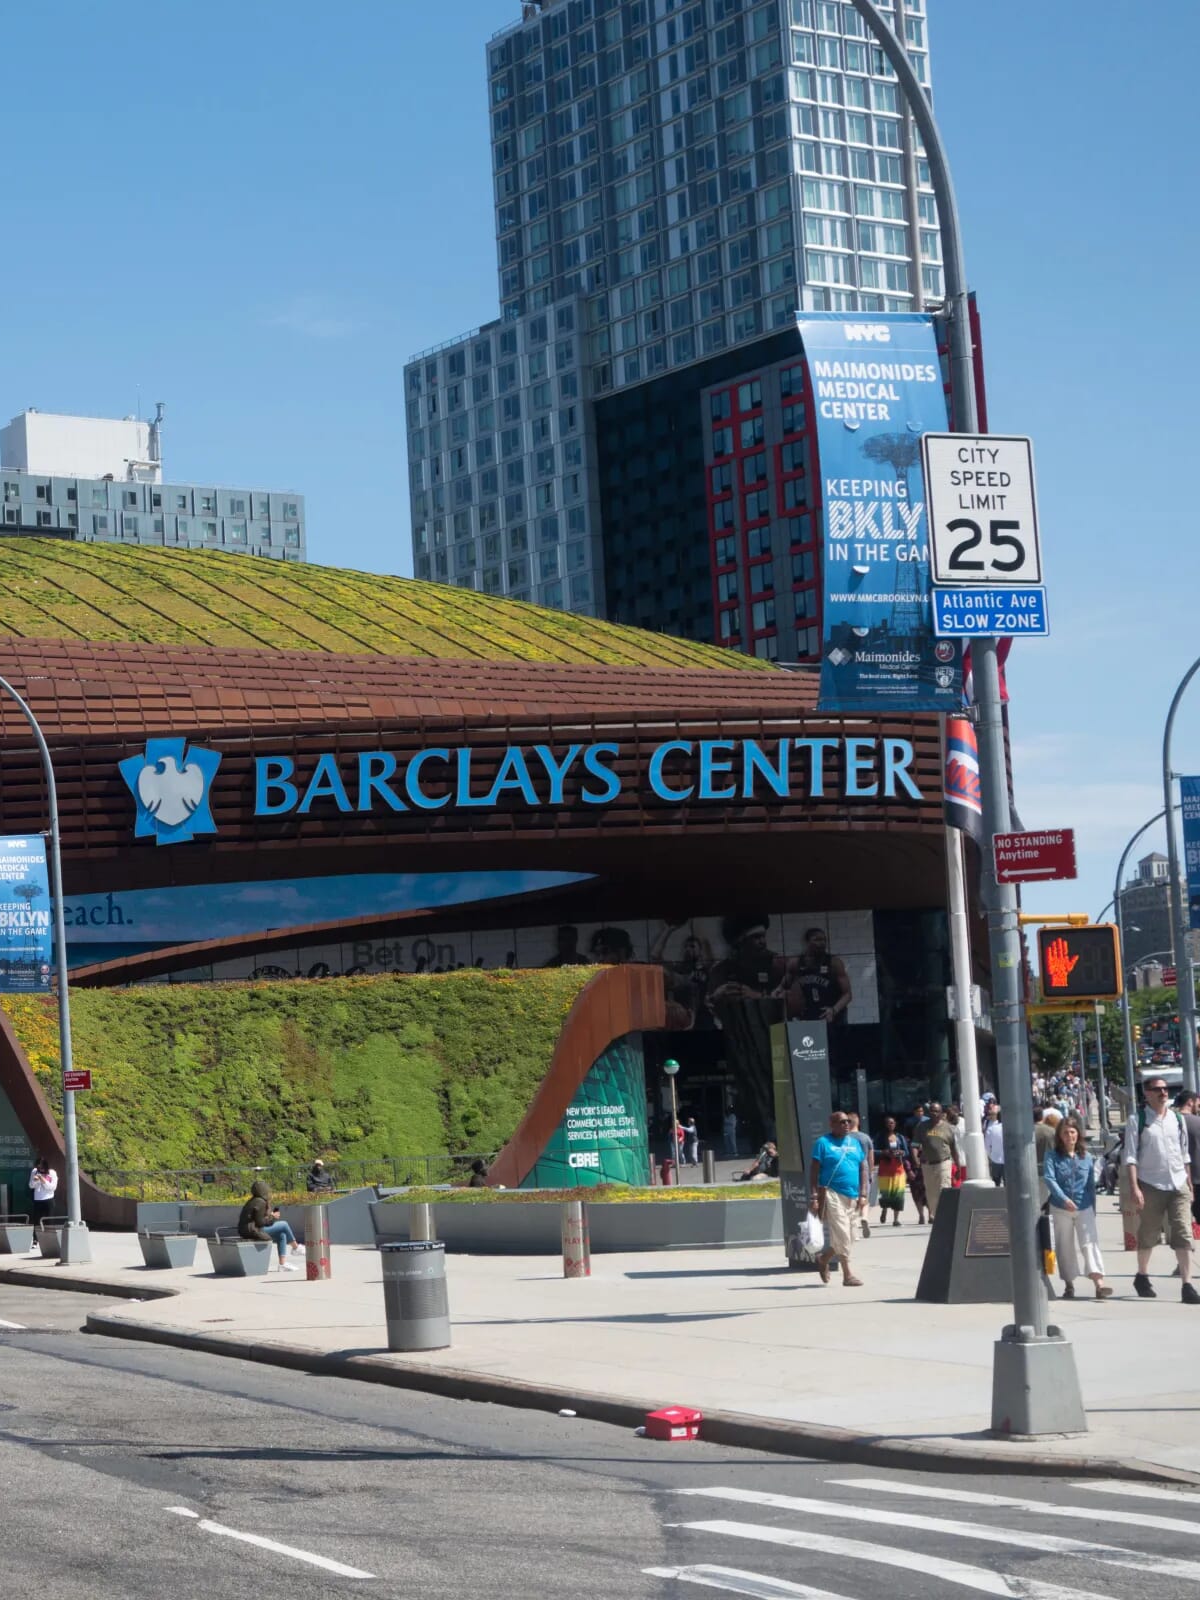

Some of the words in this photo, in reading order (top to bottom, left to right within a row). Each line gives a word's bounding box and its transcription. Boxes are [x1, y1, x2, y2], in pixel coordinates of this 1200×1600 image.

[844, 324, 891, 341] NYC
[814, 361, 937, 382] MAIMONIDES
[818, 380, 900, 400] MEDICAL
[820, 401, 891, 421] CENTER
[958, 448, 1000, 464] CITY
[950, 470, 1011, 487] SPEED
[826, 479, 907, 498] KEEPING
[959, 494, 1006, 510] LIMIT
[828, 500, 924, 540] BKLY
[829, 543, 848, 561] IN
[854, 543, 890, 561] THE
[946, 518, 1026, 572] 25
[943, 593, 1004, 609] Atlantic
[1010, 594, 1037, 608] Ave
[943, 614, 989, 629] SLOW
[995, 613, 1040, 628] ZONE
[855, 650, 921, 663] Maimonides
[254, 743, 622, 816] BARCLAYS
[649, 738, 925, 801] CENTER
[997, 838, 1012, 848] NO
[1014, 834, 1063, 847] STANDING
[1000, 849, 1040, 862] Anytime
[50, 893, 134, 926] each.
[8, 928, 22, 936] THE
[24, 928, 47, 936] GAME
[353, 941, 405, 967] Bet
[412, 938, 456, 966] On
[566, 1108, 580, 1116] NEW
[581, 1106, 600, 1116] YORK'S
[601, 1105, 626, 1115] LEADING
[567, 1118, 603, 1128] COMMERCIAL
[604, 1117, 617, 1127] REAL
[567, 1130, 593, 1140] SERVICES
[599, 1129, 631, 1138] INVESTMENT
[568, 1152, 600, 1168] CBRE
